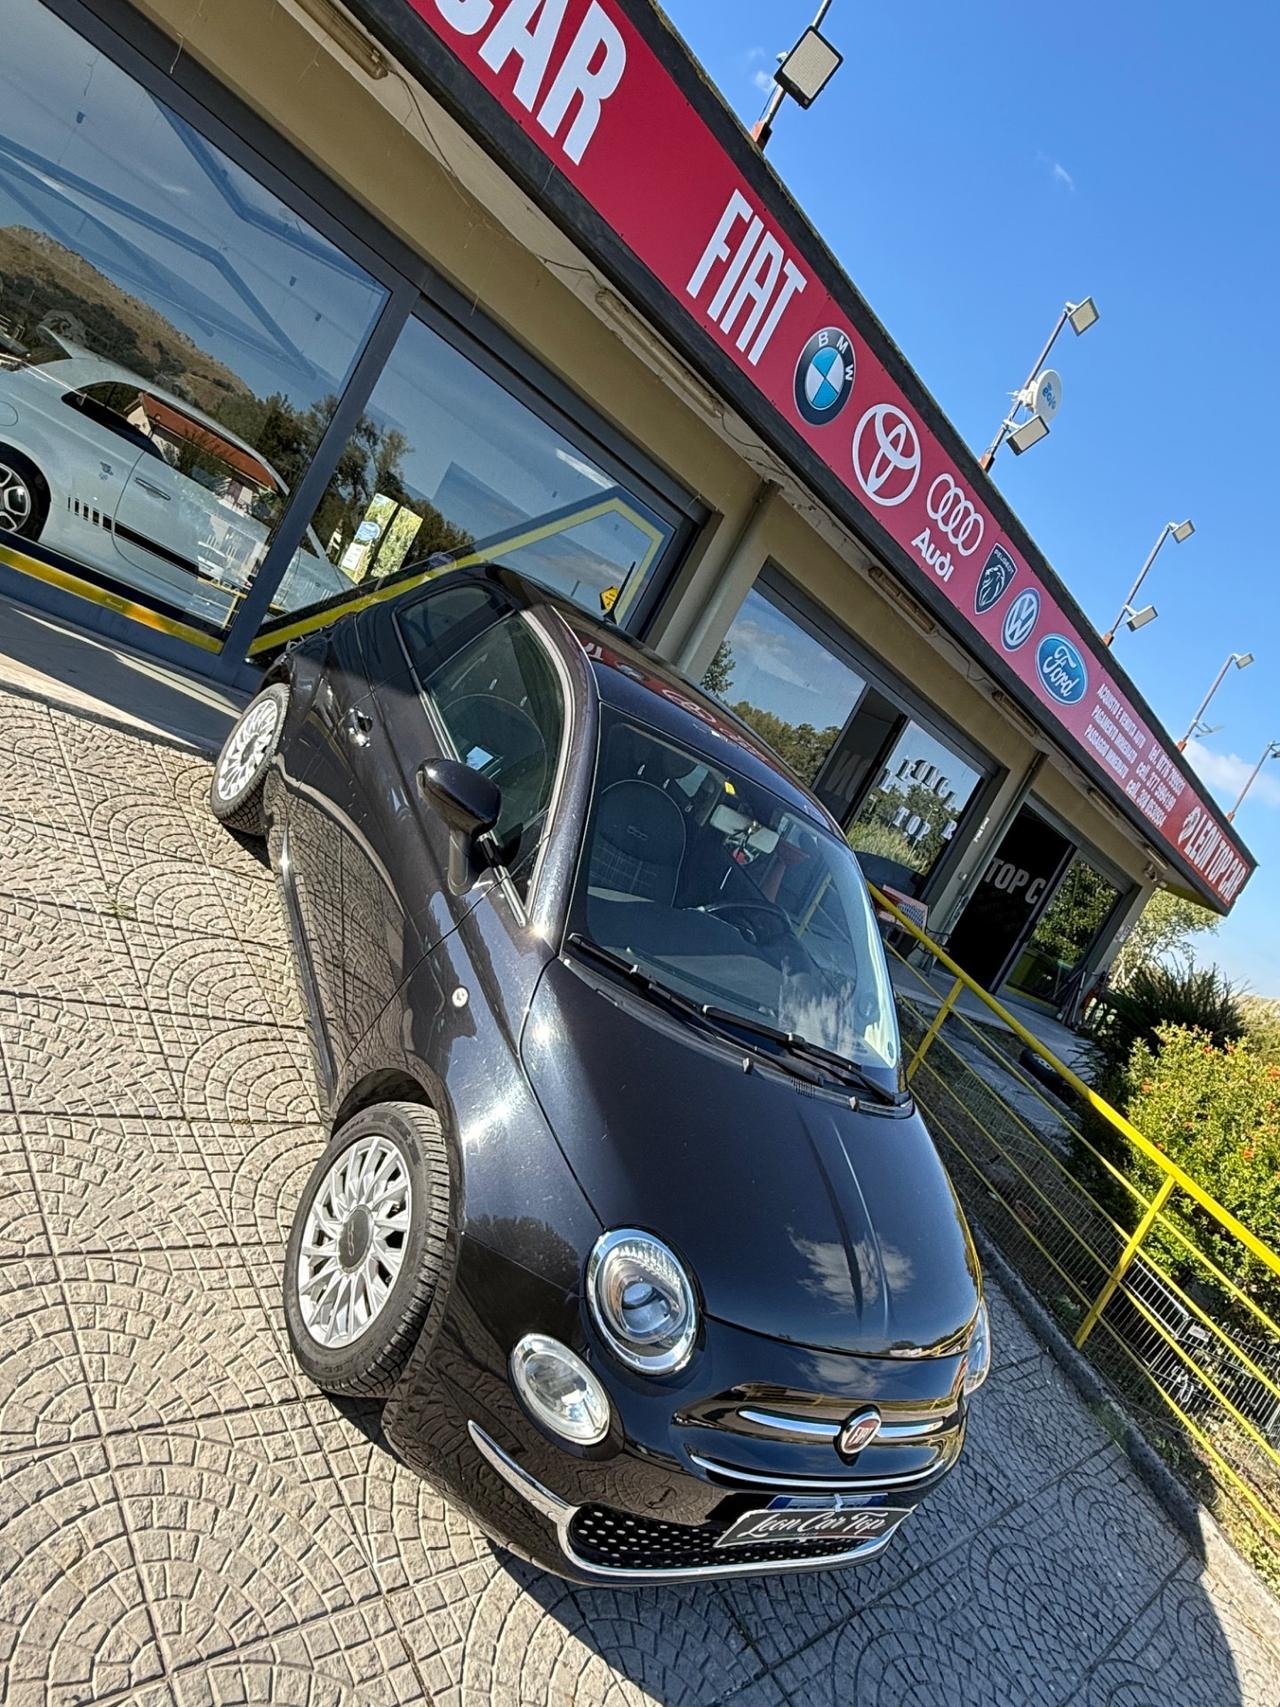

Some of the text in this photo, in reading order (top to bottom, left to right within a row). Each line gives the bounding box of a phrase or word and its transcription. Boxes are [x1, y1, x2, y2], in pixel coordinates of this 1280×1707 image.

[435, 0, 627, 166] AR
[686, 189, 807, 366] FIAT
[817, 331, 854, 381] BMW
[911, 527, 955, 583] Audi
[1042, 645, 1079, 697] Ford
[984, 857, 1029, 895] TOP
[1183, 814, 1246, 901] LEON TOP CAR
